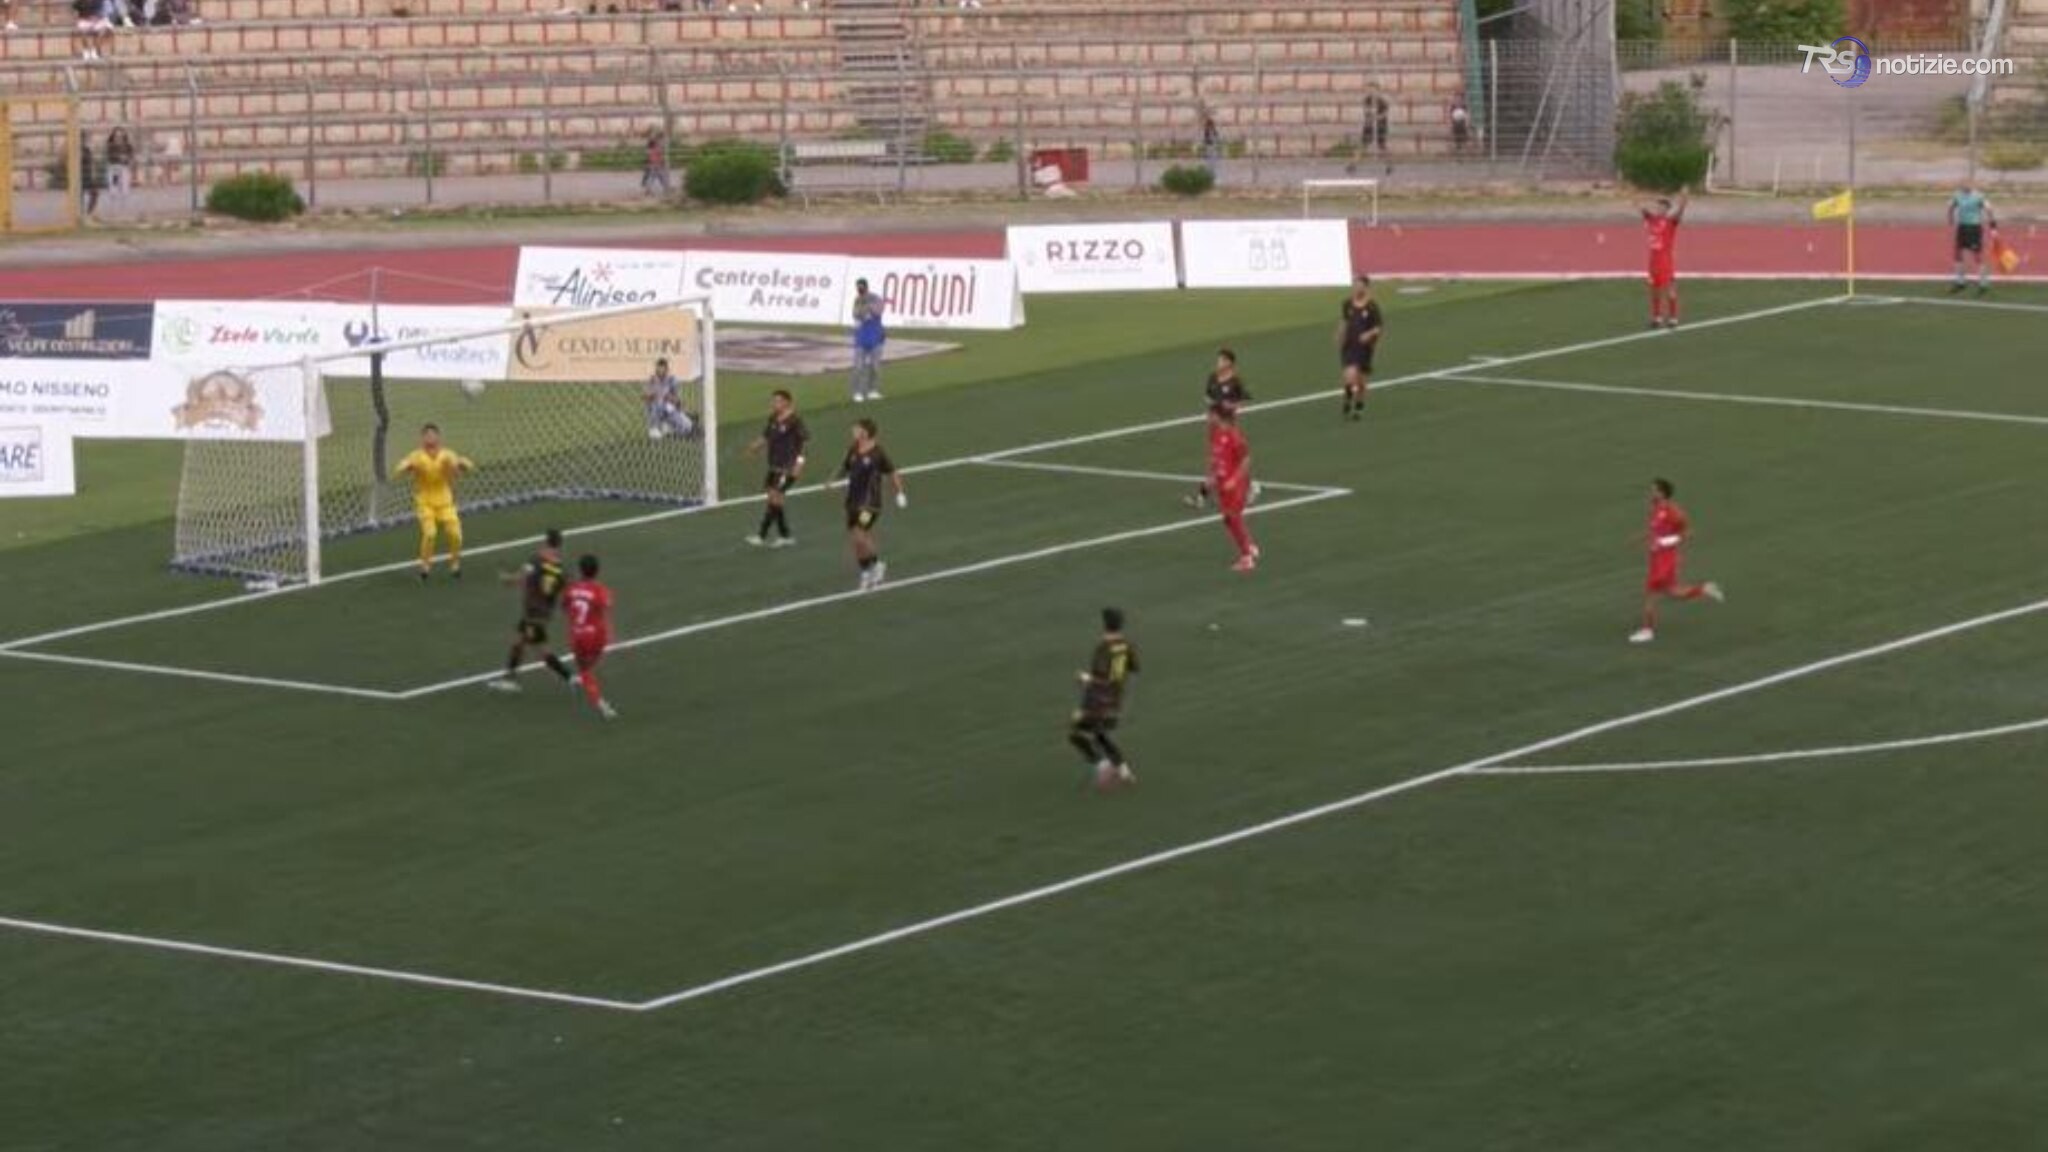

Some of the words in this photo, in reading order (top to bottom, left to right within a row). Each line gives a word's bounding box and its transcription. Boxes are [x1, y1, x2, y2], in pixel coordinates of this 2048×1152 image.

[1046, 239, 1145, 261] RIZZO
[696, 267, 832, 292] Centrolegno
[749, 287, 820, 308] Arredo
[32, 380, 110, 398] NISSENO
